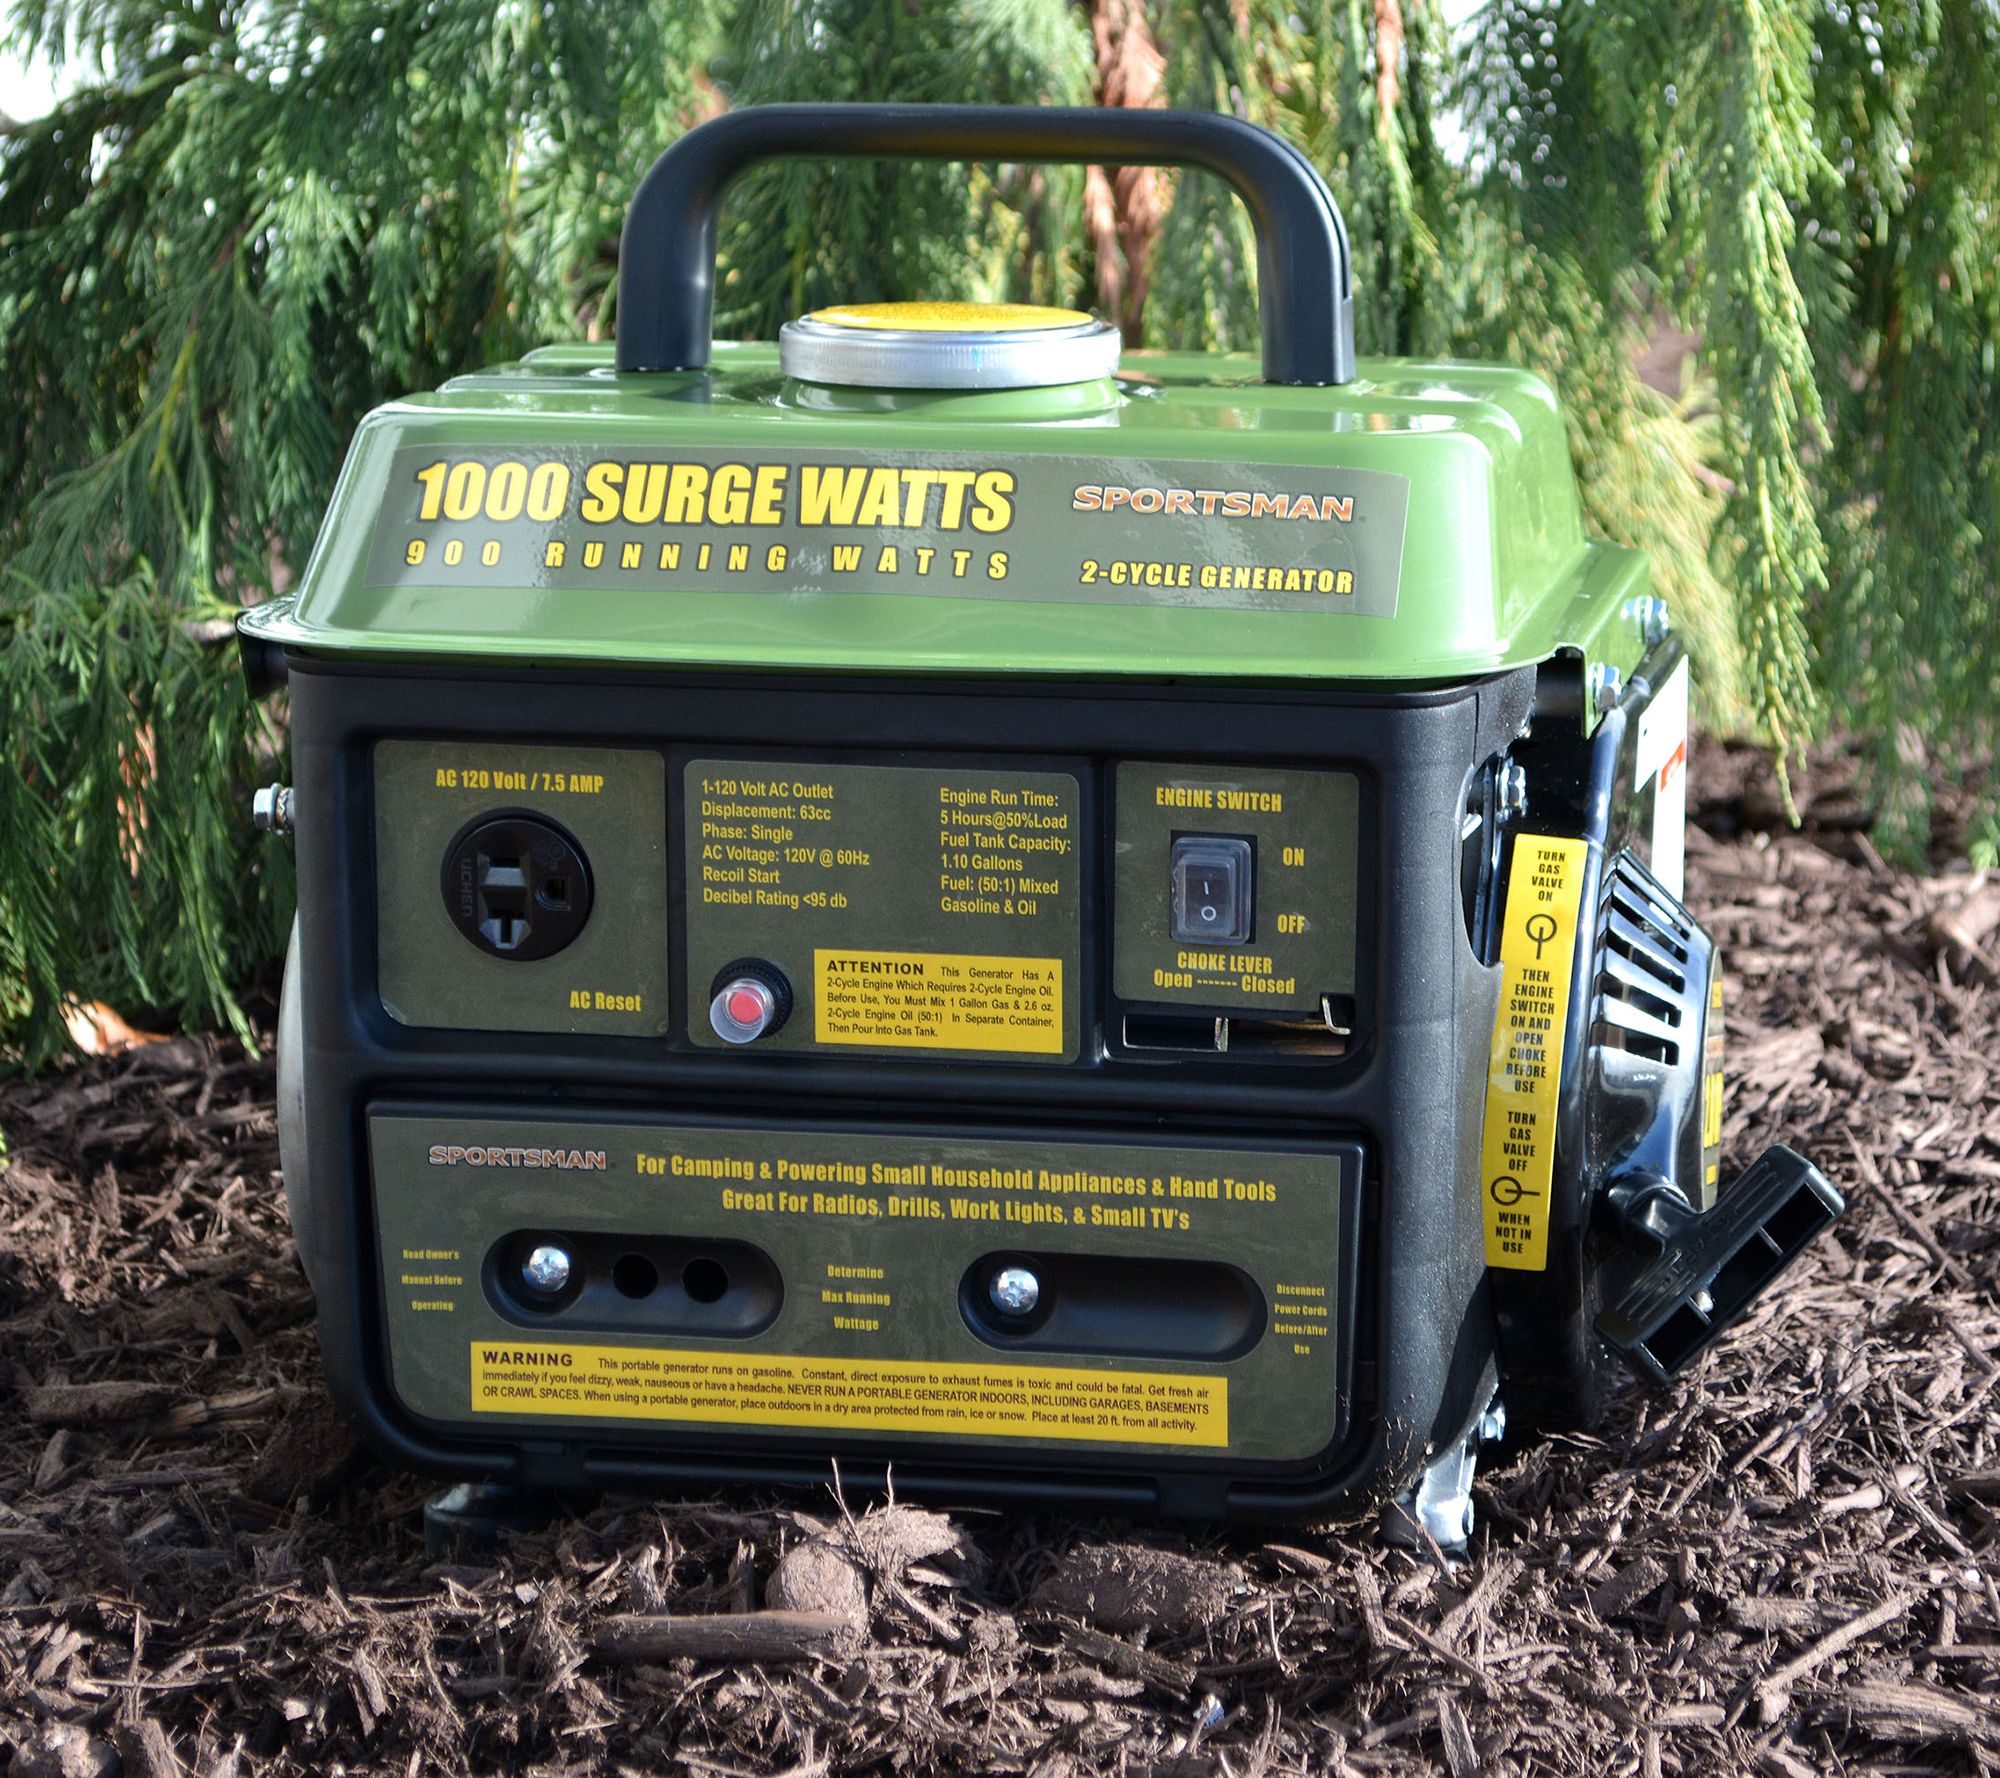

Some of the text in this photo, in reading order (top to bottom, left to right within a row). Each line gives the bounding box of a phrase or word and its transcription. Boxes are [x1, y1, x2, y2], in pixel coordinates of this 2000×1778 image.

[418, 462, 1014, 532] 1000 SURGE WATTS
[1072, 485, 1354, 522] SPORTSMAN
[407, 540, 1008, 579] 900 RUNNING WATTS
[1082, 560, 1353, 593] 2-CYCLE GENERATOR
[436, 768, 458, 788] AC
[461, 770, 490, 789] 120
[492, 771, 527, 790] Volt
[543, 773, 566, 792] 7.5
[570, 774, 604, 793] AMP
[703, 779, 833, 799] 1-120 Volt AC Outlet
[940, 787, 1059, 807] Engine Run Time:
[1156, 787, 1282, 811] ENGINE SWITCH
[702, 801, 832, 821] Displacement: 63cc
[940, 809, 1068, 831] 5 Hours@50%Load
[702, 822, 794, 844] Phase: Single
[940, 831, 1071, 855] Fuel Tank Capacity:
[703, 844, 870, 868] AC Voltage: 120V @ 60Hz
[941, 853, 1023, 872] 1.10 Gallons
[1282, 848, 1305, 866] ON
[1538, 850, 1566, 862] TURN
[703, 865, 781, 884] Recoil Start
[1538, 863, 1560, 874] GAS
[940, 874, 1059, 899] Fuel: (50:1) Mixed
[1532, 876, 1563, 889] VALVE
[704, 887, 848, 911] Decibel Rating <95 db
[1538, 890, 1553, 901] ON
[940, 896, 1037, 916] Gasoline & Oil
[1277, 914, 1305, 934] OFF
[827, 960, 924, 975] ATTENTION
[1177, 951, 1272, 973] CHOKE LEVER
[941, 966, 1055, 982] This Generator Has A
[1154, 969, 1296, 994] Open Closed
[1522, 968, 1550, 982] THEN
[827, 977, 860, 990] 2-Cycle
[862, 978, 894, 992] Engine
[896, 980, 924, 991] Which
[927, 981, 967, 994] Requires
[970, 983, 1003, 996] 2-Cycle
[1005, 984, 1036, 998] Engine
[1515, 984, 1554, 998] ENGINE
[570, 991, 641, 1011] AC Reset
[1510, 999, 1555, 1014] SWITCH
[1510, 1015, 1551, 1030] ON AND
[1515, 1032, 1544, 1045] OPEN
[1509, 1047, 1546, 1062] CHOKE
[1506, 1062, 1546, 1078] BEFORE
[1514, 1080, 1535, 1093] USE
[1508, 1111, 1536, 1125] TURN
[1509, 1127, 1532, 1141] GAS
[429, 1145, 607, 1170] SPORTSMAN
[1503, 1142, 1535, 1157] VALVE
[1508, 1158, 1528, 1171] OFF
[637, 1153, 1277, 1201] For Camping & Powering Small Household Appliances & Hand Tools
[722, 1189, 1190, 1230] Great For Radios, Drills, Work Lights, & Small TV's
[1498, 1212, 1530, 1226] WHEN
[1496, 1226, 1532, 1240] NOT IN
[1502, 1241, 1523, 1254] USE
[827, 1264, 885, 1279] Determine
[822, 1291, 891, 1308] Max Running
[834, 1316, 879, 1330] Wattage
[482, 1351, 572, 1367] WARNING
[483, 1370, 540, 1384] immediately
[542, 1371, 548, 1382] if
[549, 1375, 567, 1385] you
[569, 1373, 586, 1384] feel
[644, 1379, 691, 1389] nauseous
[692, 1381, 703, 1390] or
[704, 1379, 728, 1391] have
[729, 1383, 735, 1392] a
[788, 1383, 822, 1396] NEVER
[824, 1385, 846, 1397] RUN
[848, 1386, 856, 1397] A
[857, 1387, 912, 1400] PORTABLE
[914, 1389, 978, 1402] GENERATOR
[1032, 1394, 1087, 1408] INCLUDING
[1146, 1400, 1209, 1415] BASEMENTS
